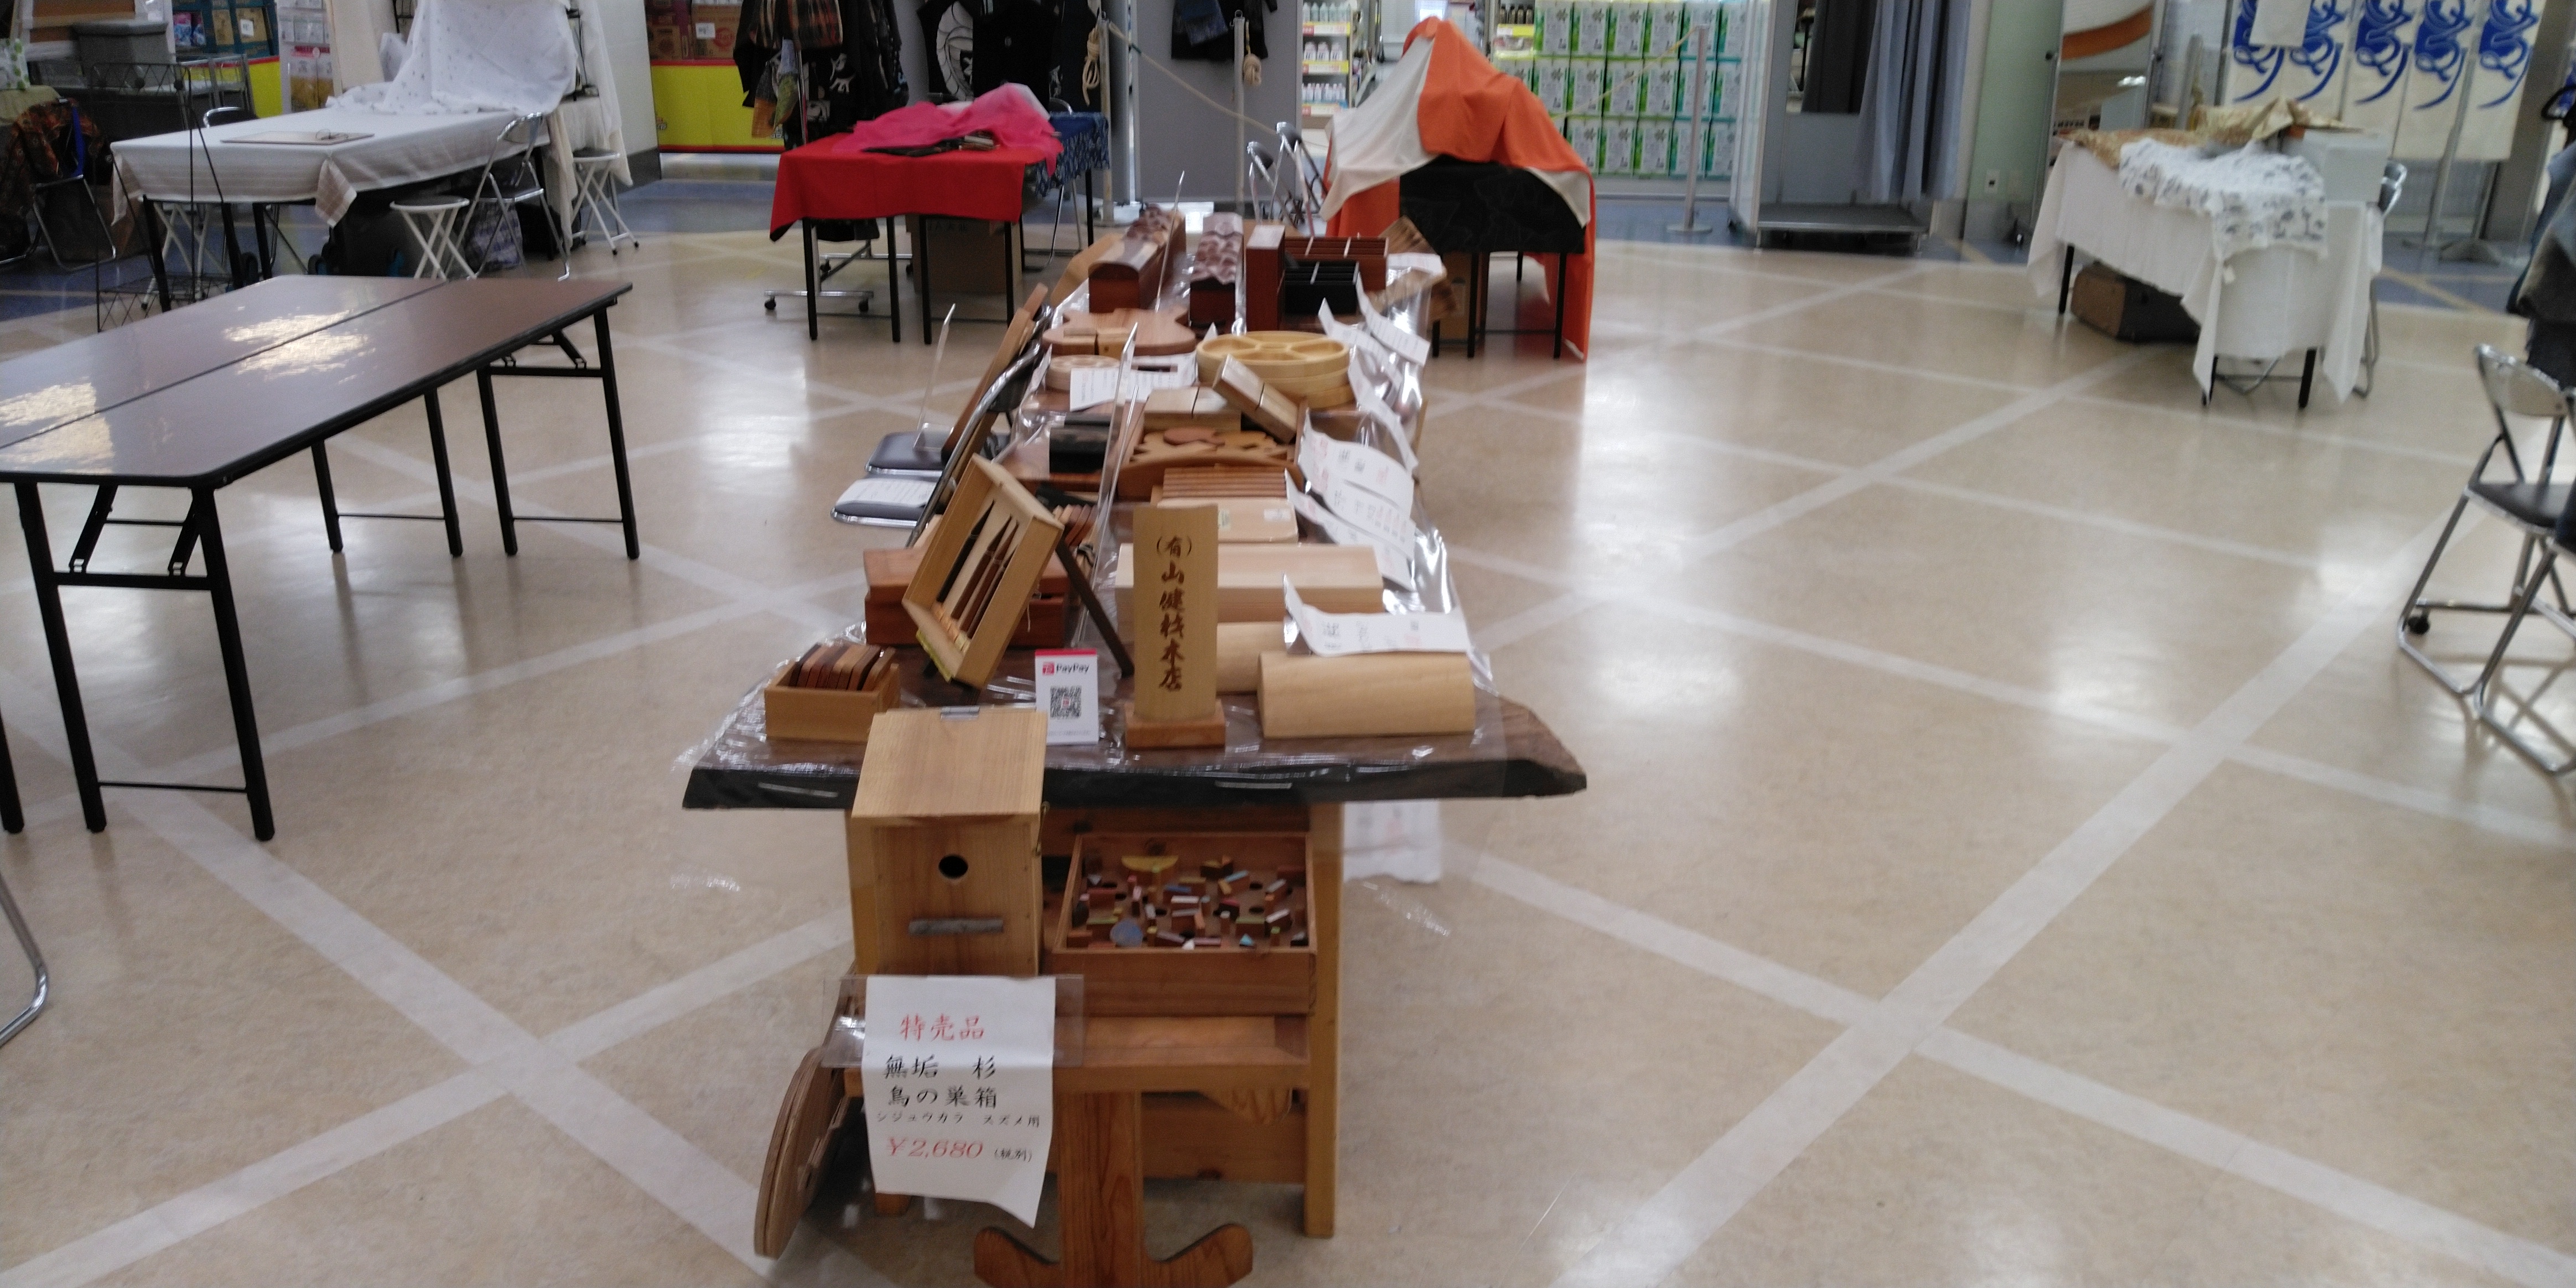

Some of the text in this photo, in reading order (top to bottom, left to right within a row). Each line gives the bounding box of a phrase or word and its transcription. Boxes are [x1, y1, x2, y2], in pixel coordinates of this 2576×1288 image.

[1056, 662, 1090, 674] PayPay
[900, 1013, 985, 1042] 特売品
[885, 1054, 996, 1079] 無垢 杉
[888, 1085, 997, 1109] 鳥の巣箱
[877, 1111, 964, 1124] シジュウカラ
[887, 1136, 984, 1159] ¥2,680
